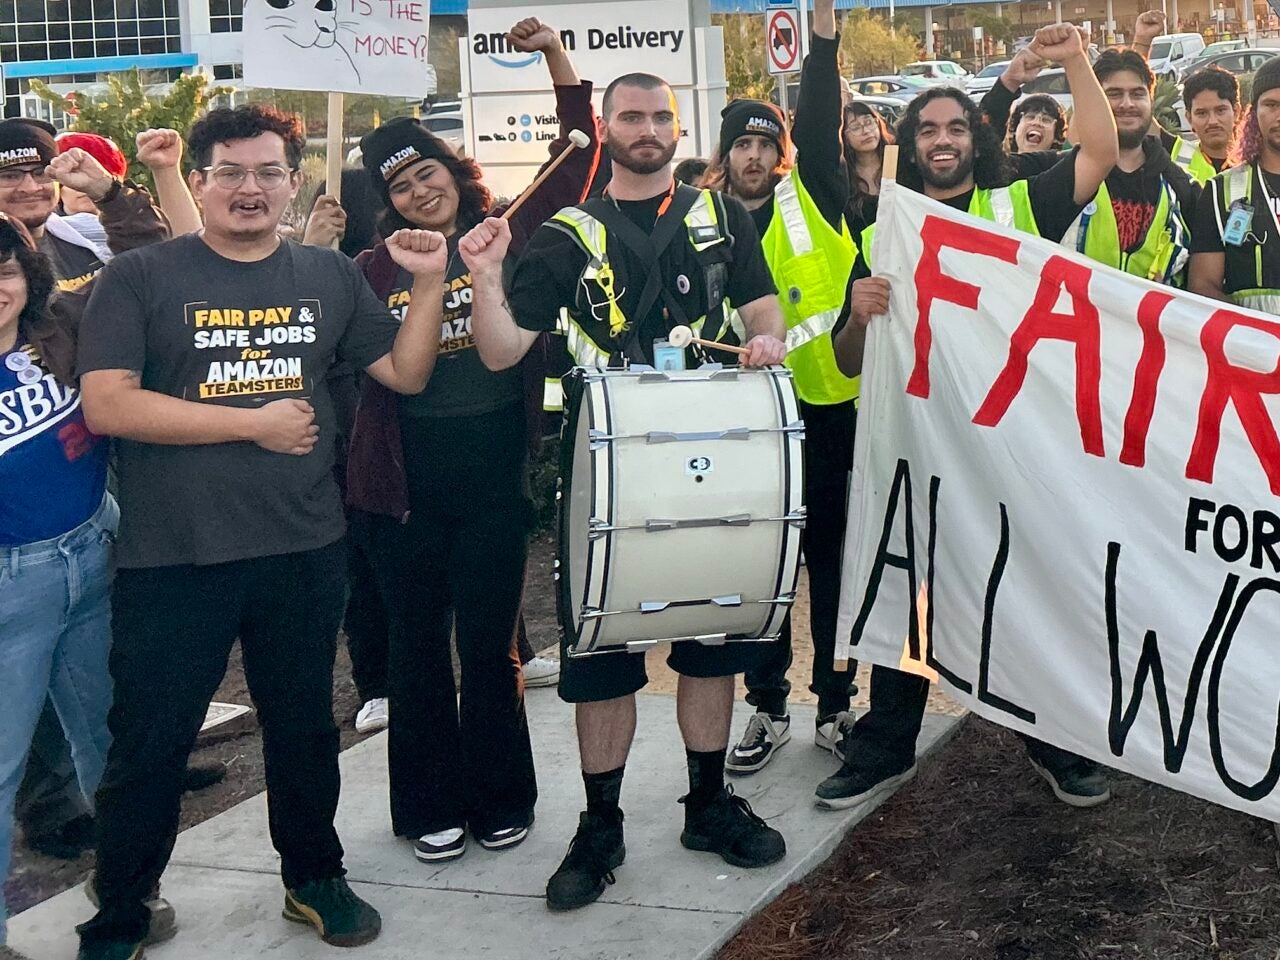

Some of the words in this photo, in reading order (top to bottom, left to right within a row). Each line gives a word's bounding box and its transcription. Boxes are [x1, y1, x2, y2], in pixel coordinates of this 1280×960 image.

[355, 35, 427, 62] MONEY?
[588, 26, 684, 53] Delivery
[536, 131, 556, 141] Line
[0, 147, 37, 161] MAZON
[195, 309, 245, 327] FAIR
[249, 307, 292, 326] PAY
[298, 306, 314, 323] &
[194, 329, 250, 349] SAFE
[255, 325, 316, 345] JOBS
[240, 348, 271, 360] for
[206, 357, 302, 383] AMAZON
[205, 378, 300, 395] TEAMSTERS
[850, 459, 1036, 725] ALL
